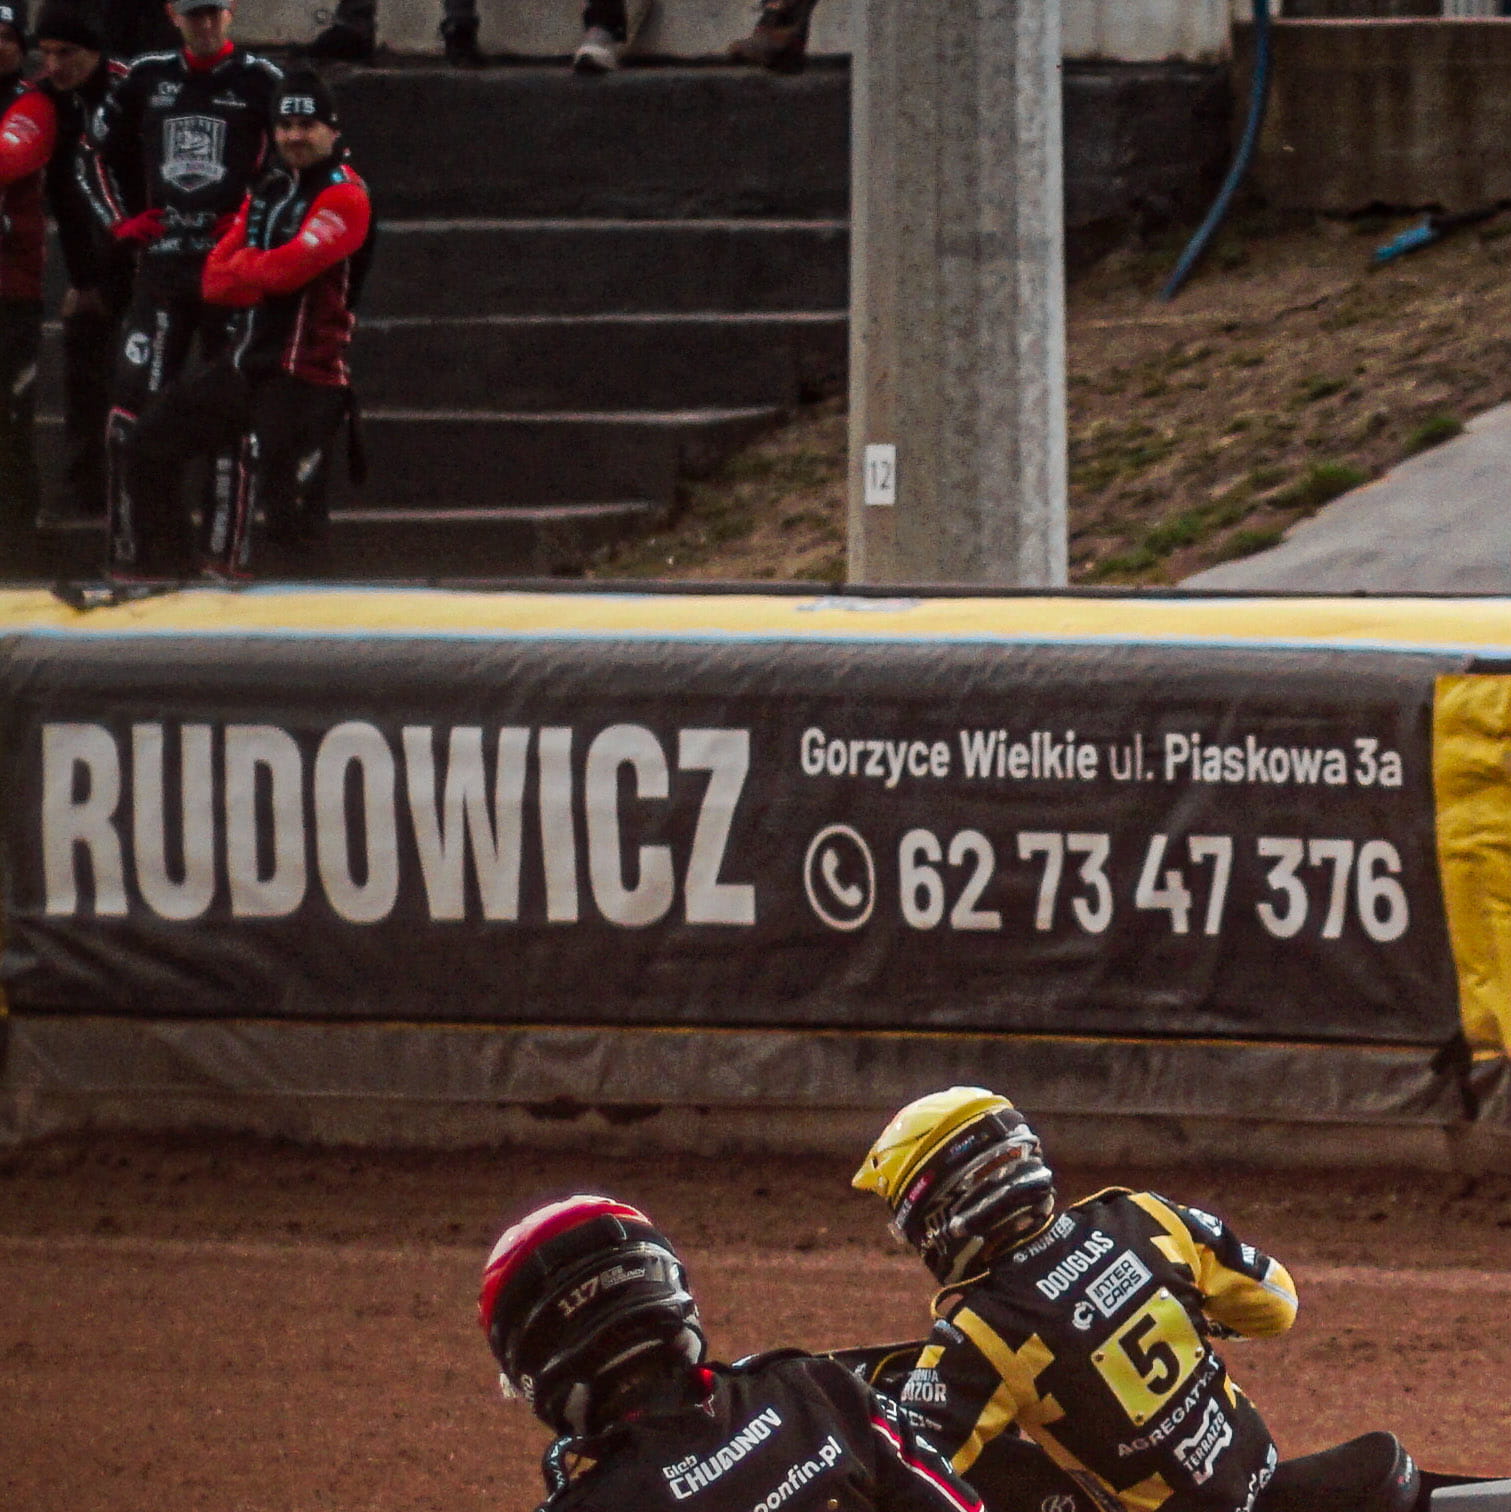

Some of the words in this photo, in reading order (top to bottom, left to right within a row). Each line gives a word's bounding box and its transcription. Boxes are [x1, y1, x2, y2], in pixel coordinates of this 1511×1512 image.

[800, 726, 950, 788] Gorzyce
[960, 730, 1097, 781] Wielkie
[1109, 733, 1154, 782] ul.
[1164, 733, 1345, 786] Piaskowa
[1354, 738, 1402, 786] 3a
[42, 721, 756, 927] RUDOWICZ
[899, 828, 1001, 932] 62
[1016, 831, 1113, 934] 73
[1135, 834, 1232, 936] 47
[1256, 836, 1410, 943] 376
[1036, 1230, 1114, 1300] DOUGLAS
[1092, 1259, 1134, 1298] INTER
[1102, 1270, 1143, 1310] CARS
[1118, 1313, 1181, 1395] 5
[662, 1454, 698, 1480] Gleb
